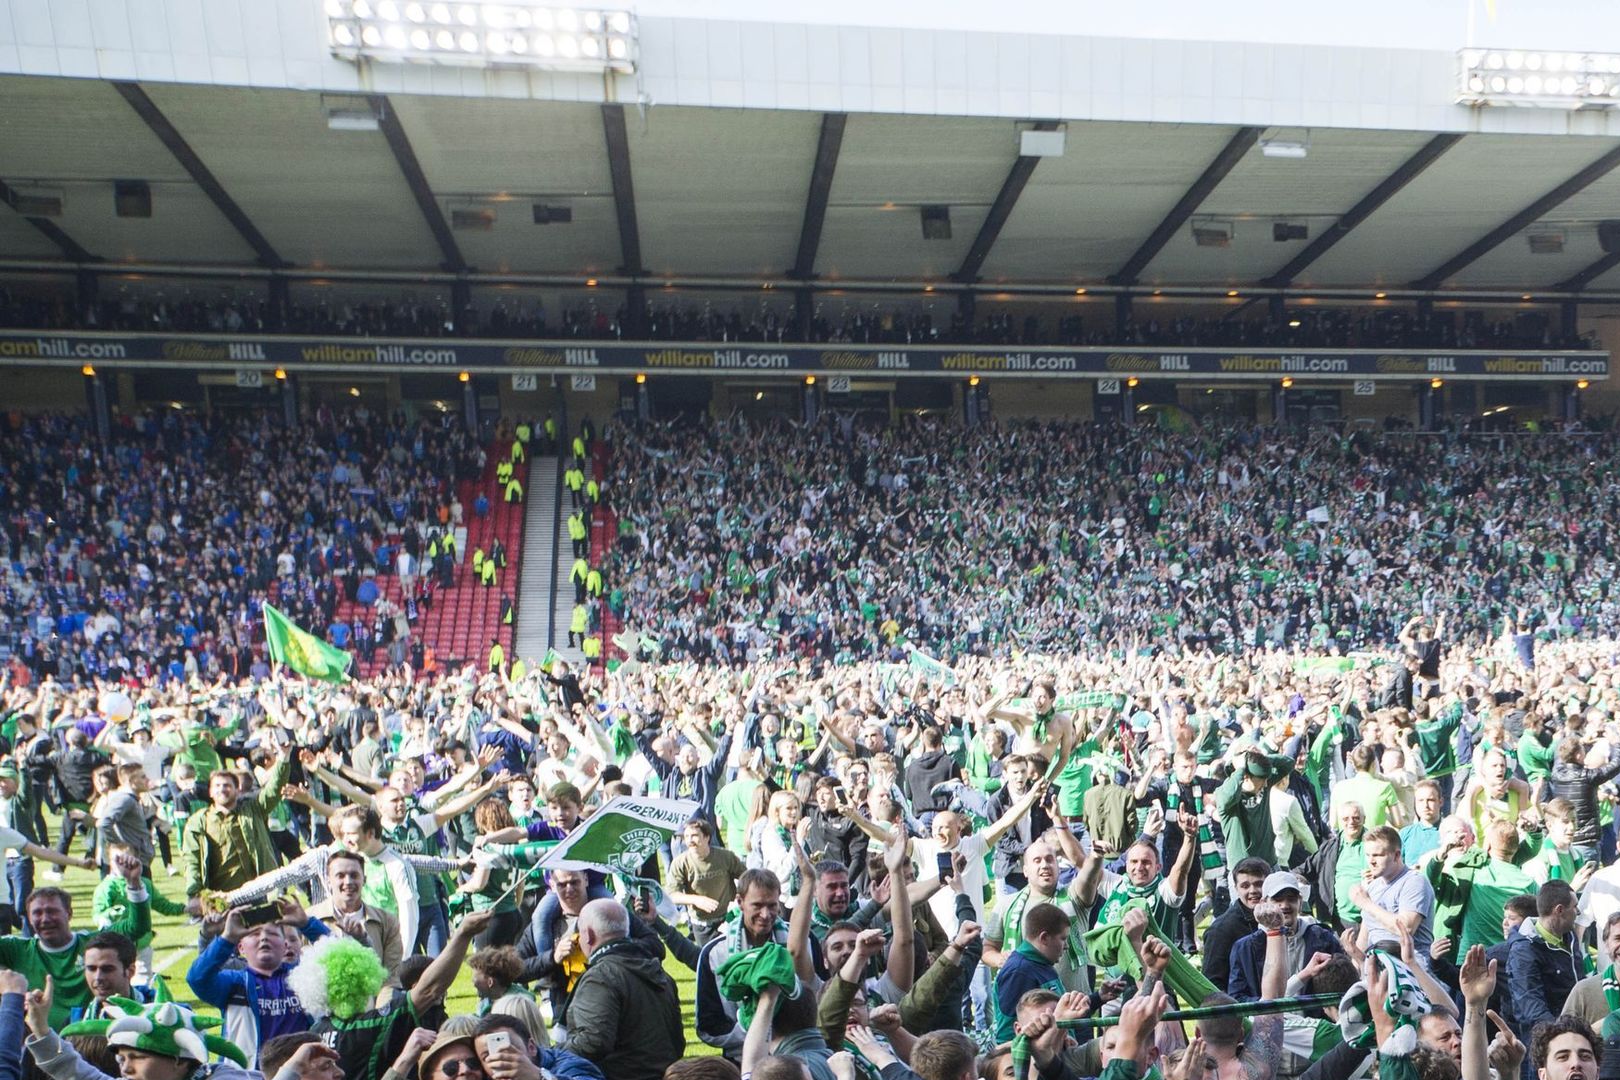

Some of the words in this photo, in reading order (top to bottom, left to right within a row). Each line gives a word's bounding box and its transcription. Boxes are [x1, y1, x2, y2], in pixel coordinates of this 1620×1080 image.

[229, 344, 265, 360] HILL
[302, 345, 456, 364] williamhill.com
[566, 349, 598, 366] HILL
[646, 350, 789, 368] williamhill.com
[878, 352, 910, 369] HILL
[941, 353, 1076, 370] williamhill.com
[1160, 356, 1190, 370] HILL
[1219, 356, 1348, 371] williamhill.com
[1427, 357, 1456, 371] HILL
[1483, 358, 1606, 372] williamhill.com
[574, 376, 592, 389] 22
[831, 379, 849, 391] 23
[1100, 381, 1117, 392] 24
[1357, 382, 1373, 393] 25
[614, 802, 681, 826] HIBERNIAN
